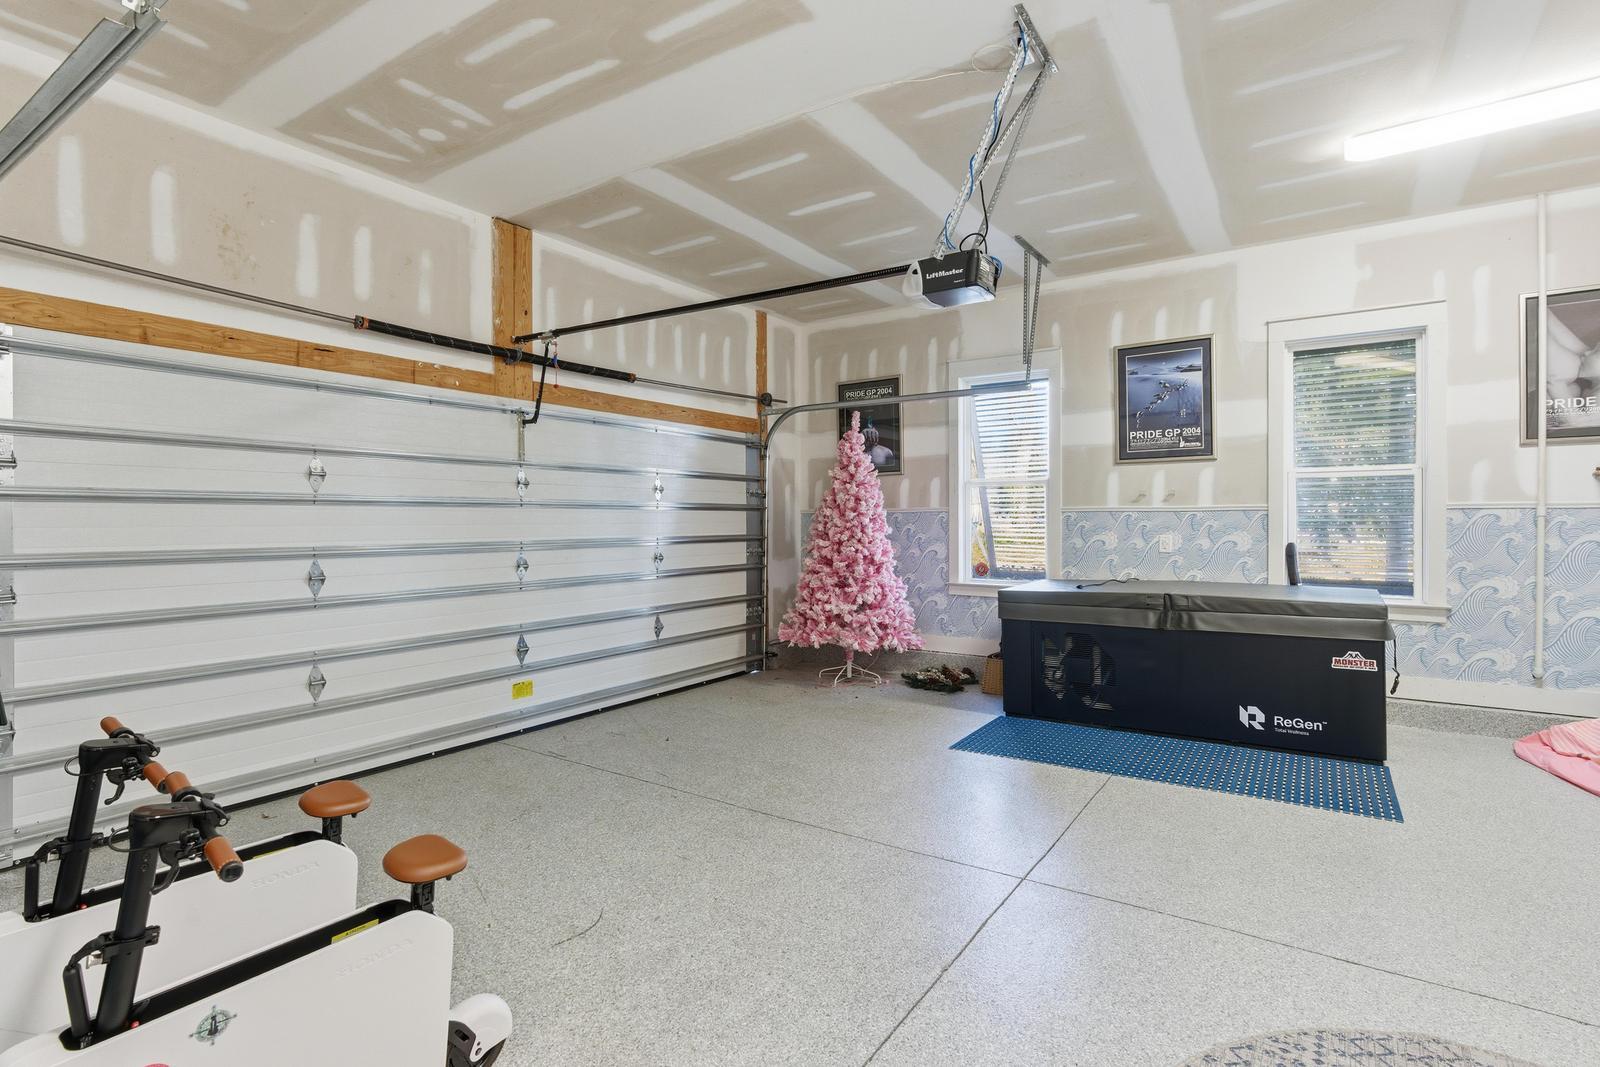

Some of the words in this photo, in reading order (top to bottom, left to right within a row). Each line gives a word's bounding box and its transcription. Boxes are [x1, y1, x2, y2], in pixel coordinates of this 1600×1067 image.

[926, 268, 964, 279] LiftMaster
[845, 390, 865, 398] PRIDE
[866, 388, 877, 396] GP
[877, 387, 892, 395] 2004
[1130, 429, 1163, 440] PRIDE
[1165, 428, 1181, 437] GP
[1182, 426, 1201, 435] 2004
[1334, 658, 1375, 668] MONSTER
